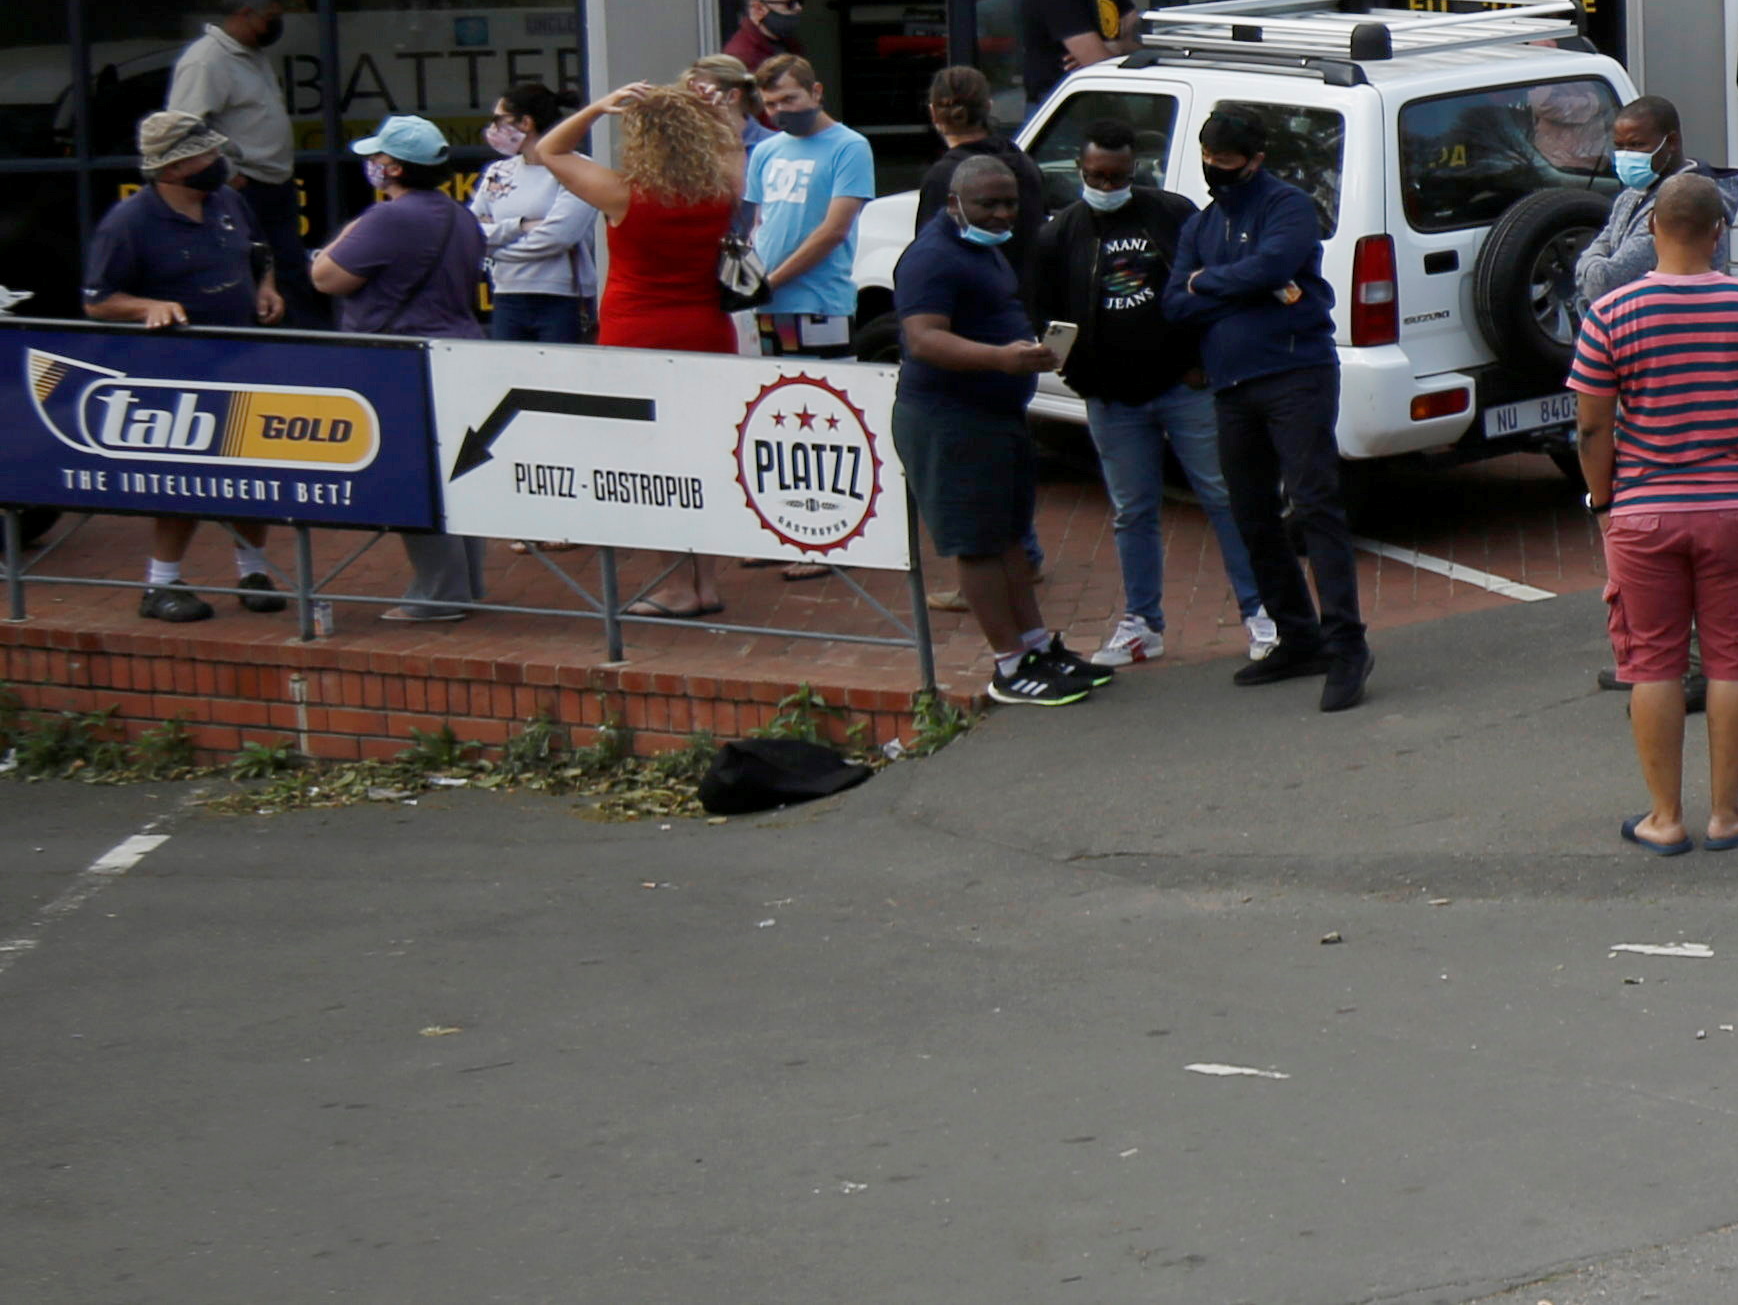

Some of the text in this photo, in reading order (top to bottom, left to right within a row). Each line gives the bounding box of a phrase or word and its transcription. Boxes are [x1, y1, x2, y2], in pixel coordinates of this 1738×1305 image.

[1106, 238, 1148, 255] MANI
[1105, 287, 1155, 310] JEANS
[1404, 309, 1450, 325] SUZUKI
[97, 390, 353, 451] tab GOLD
[1497, 406, 1518, 432] NU
[755, 439, 865, 502] PLATZZ
[63, 467, 354, 507] THE INTELLIGENT BET!
[515, 461, 578, 500] PLATZZ
[594, 469, 705, 511] GASTROPUB
[778, 514, 848, 536] GASTROPUB
